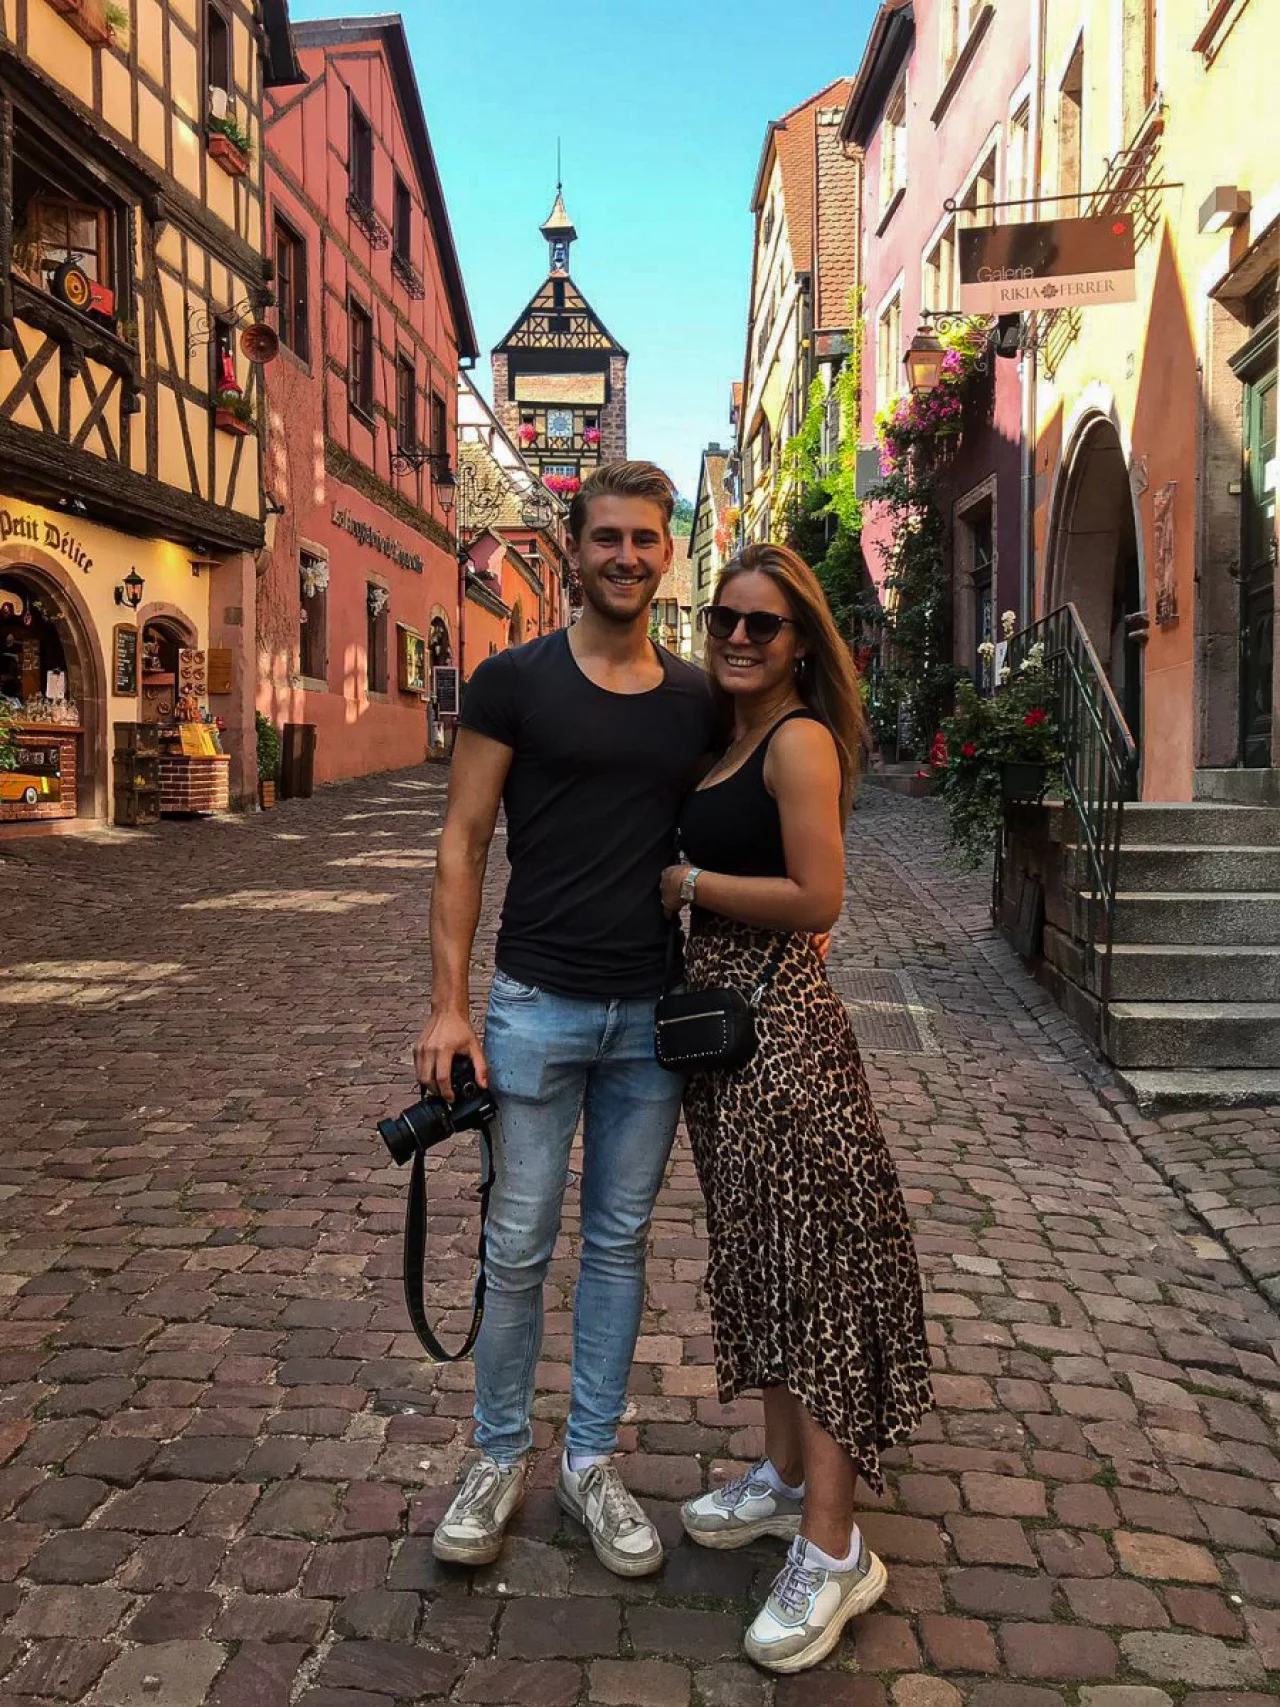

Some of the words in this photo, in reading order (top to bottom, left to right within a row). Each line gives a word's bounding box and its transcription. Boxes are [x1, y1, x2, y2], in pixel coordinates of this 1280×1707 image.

[978, 265, 1034, 283] Galerie
[1000, 286, 1039, 301] RIKIA
[1060, 279, 1115, 297] FERRER
[0, 509, 39, 542] Petit
[43, 521, 94, 574] Délice
